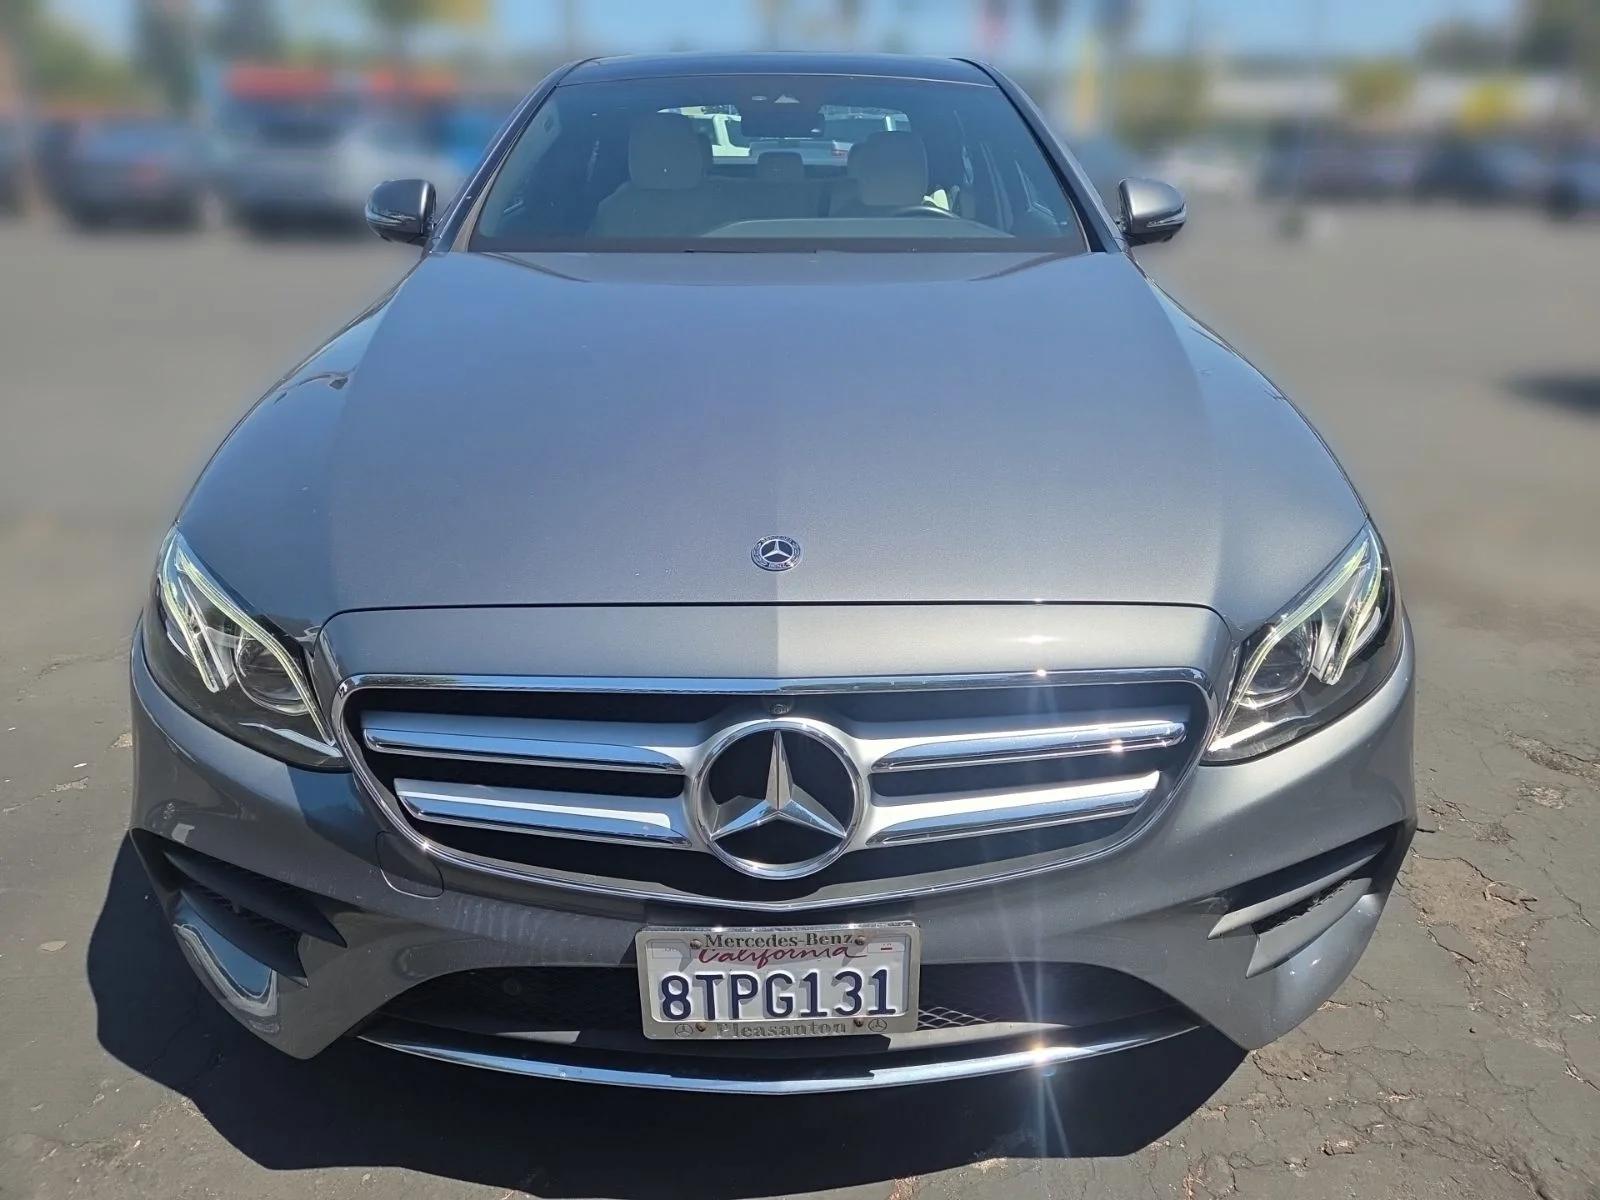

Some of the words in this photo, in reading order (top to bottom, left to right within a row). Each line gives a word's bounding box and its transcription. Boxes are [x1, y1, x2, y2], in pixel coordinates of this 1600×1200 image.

[704, 932, 854, 949] Mercedes-Benz
[697, 946, 867, 969] California
[660, 969, 896, 1020] 8TPG131
[715, 1020, 847, 1038] Pleasanton
